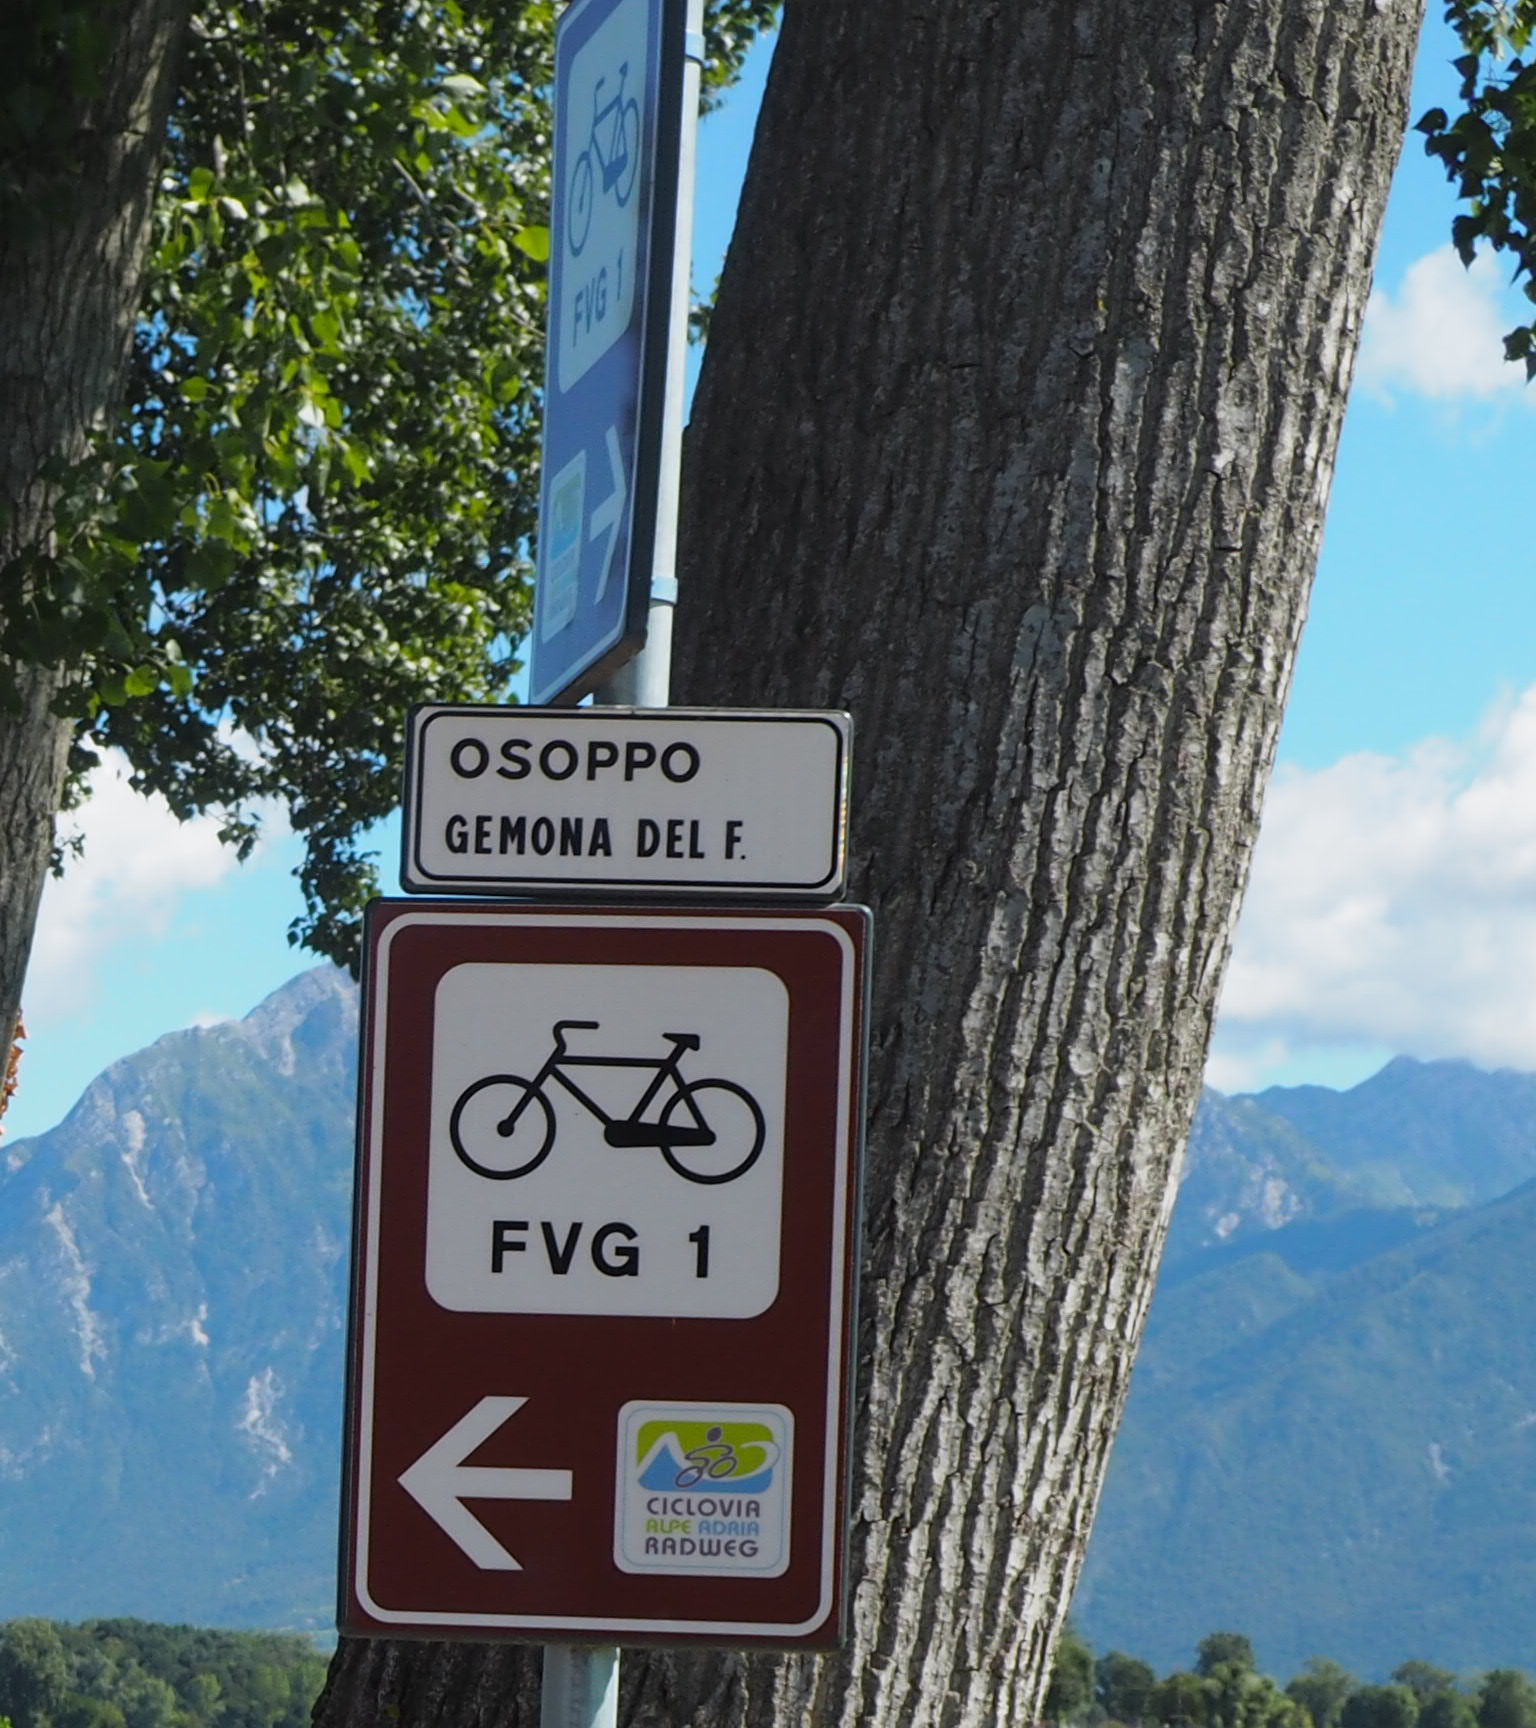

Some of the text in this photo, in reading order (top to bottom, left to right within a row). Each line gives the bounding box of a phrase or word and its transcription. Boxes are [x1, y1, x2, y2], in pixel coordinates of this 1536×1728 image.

[573, 267, 607, 348] FVG
[449, 737, 701, 784] OSOPPO
[444, 813, 747, 861] GEMONA DEL F.
[490, 1219, 711, 1279] FVG 1
[644, 1517, 760, 1537] ALPE ADRIA
[646, 1496, 761, 1518] CICLOVIA
[644, 1536, 759, 1558] RADWEG
